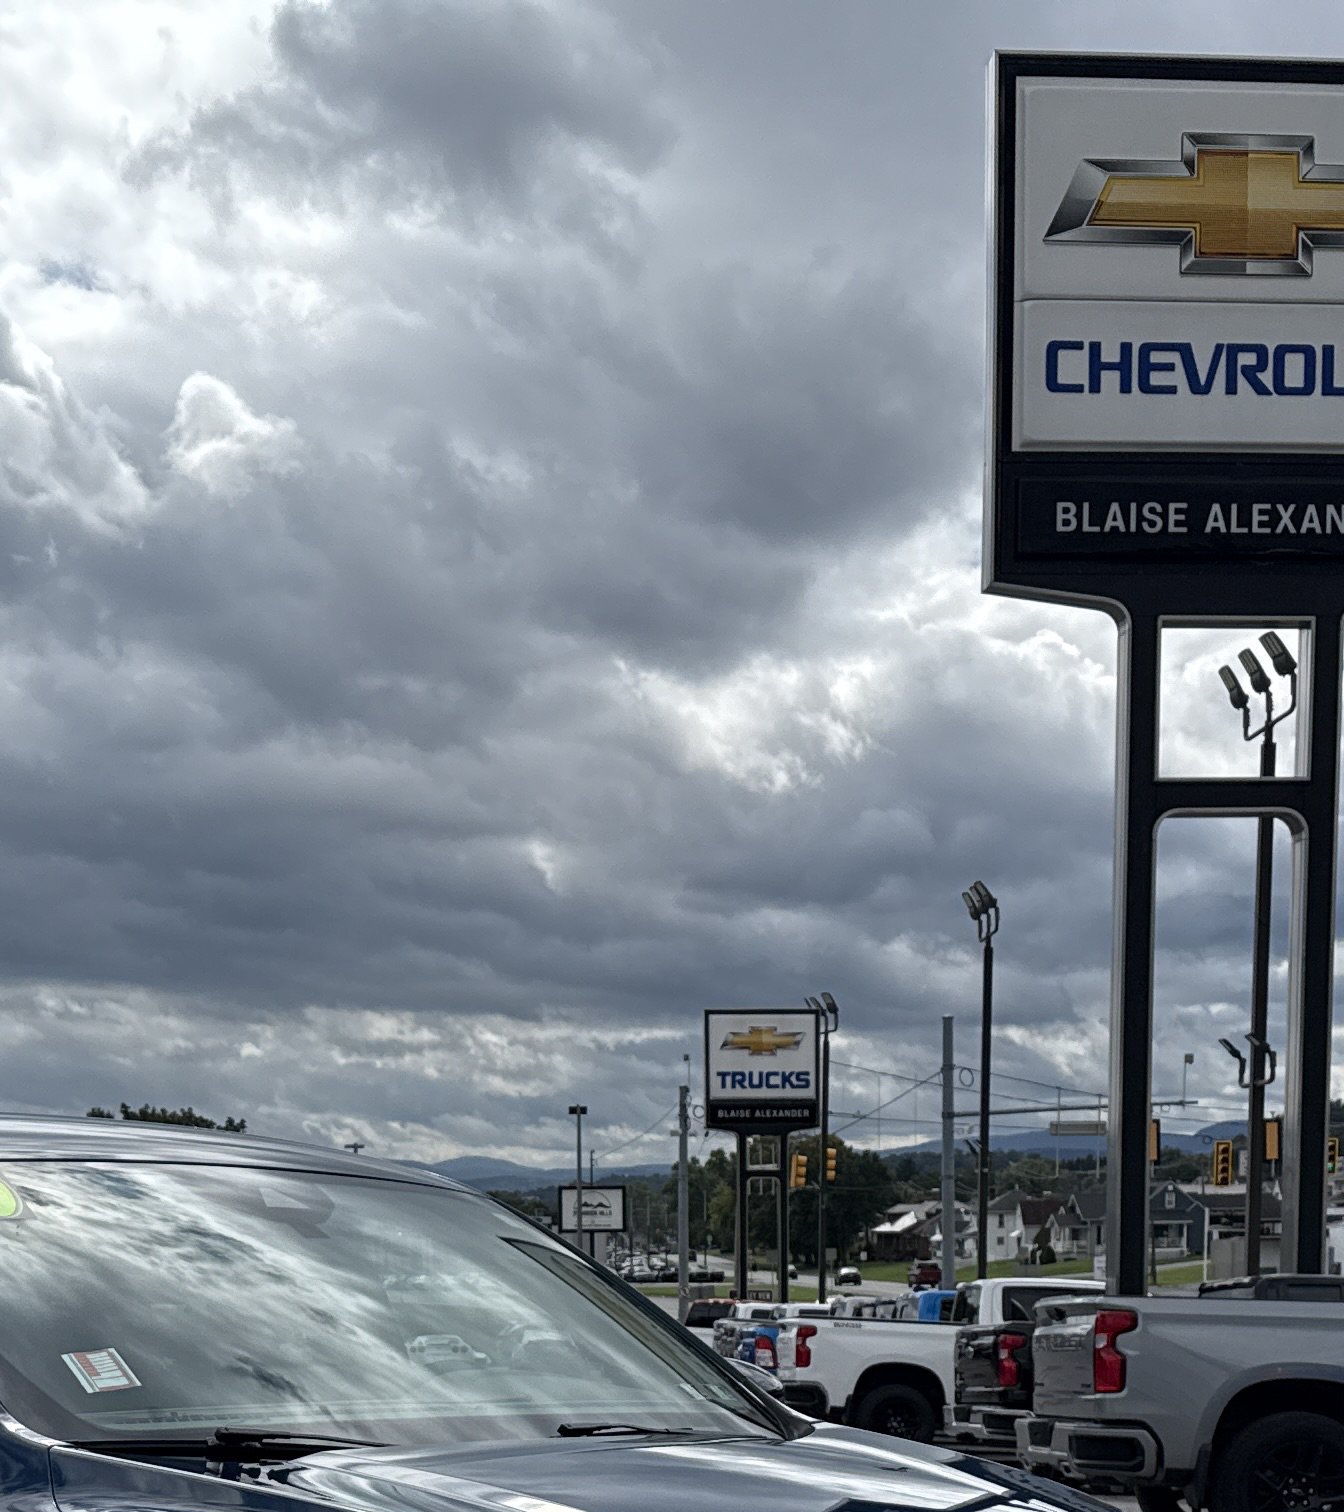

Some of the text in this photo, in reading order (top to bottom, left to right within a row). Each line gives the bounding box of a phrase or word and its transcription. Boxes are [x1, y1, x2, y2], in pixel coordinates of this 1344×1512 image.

[1056, 501, 1189, 534] BLAISE
[716, 1071, 811, 1090] TRUCKS
[717, 1108, 810, 1119] BLAISE ALEXANDER
